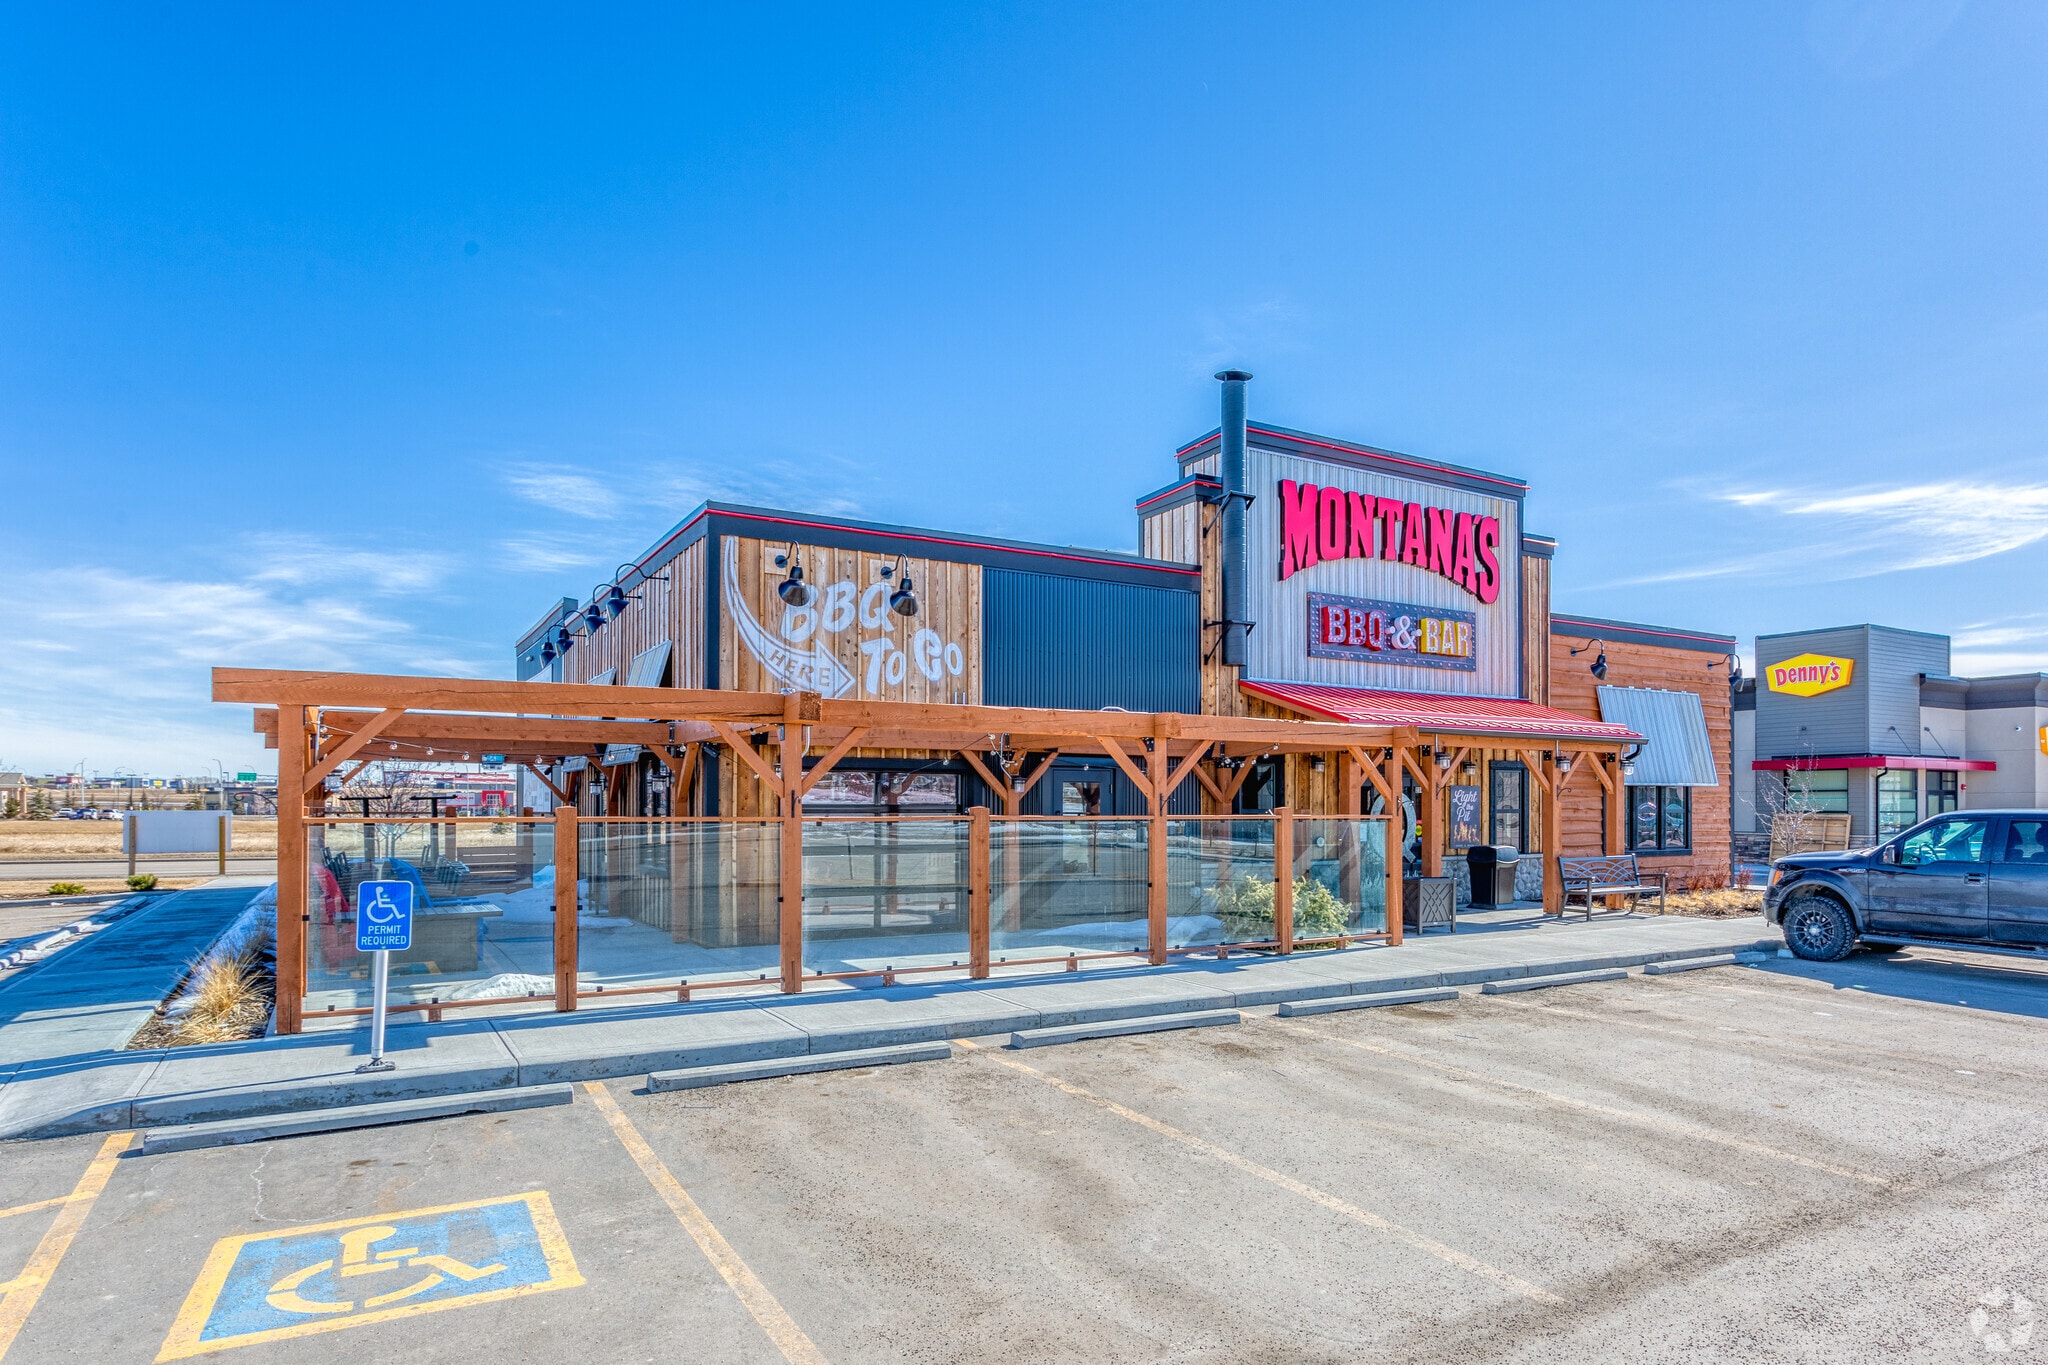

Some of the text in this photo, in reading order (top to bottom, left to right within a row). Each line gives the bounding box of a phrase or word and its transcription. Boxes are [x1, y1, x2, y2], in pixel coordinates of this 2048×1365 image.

[1279, 479, 1500, 604] MONTANA'S
[781, 580, 895, 643] BBQ
[1321, 606, 1472, 657] BBQ & BAR
[769, 649, 831, 688] HERE
[860, 628, 963, 695] To Go
[1774, 661, 1841, 686] Denny's
[1453, 789, 1477, 808] Light
[1466, 803, 1475, 811] the
[1456, 806, 1471, 822] Pit
[361, 935, 407, 946] REQUIRED
[368, 925, 402, 935] PERMIT
